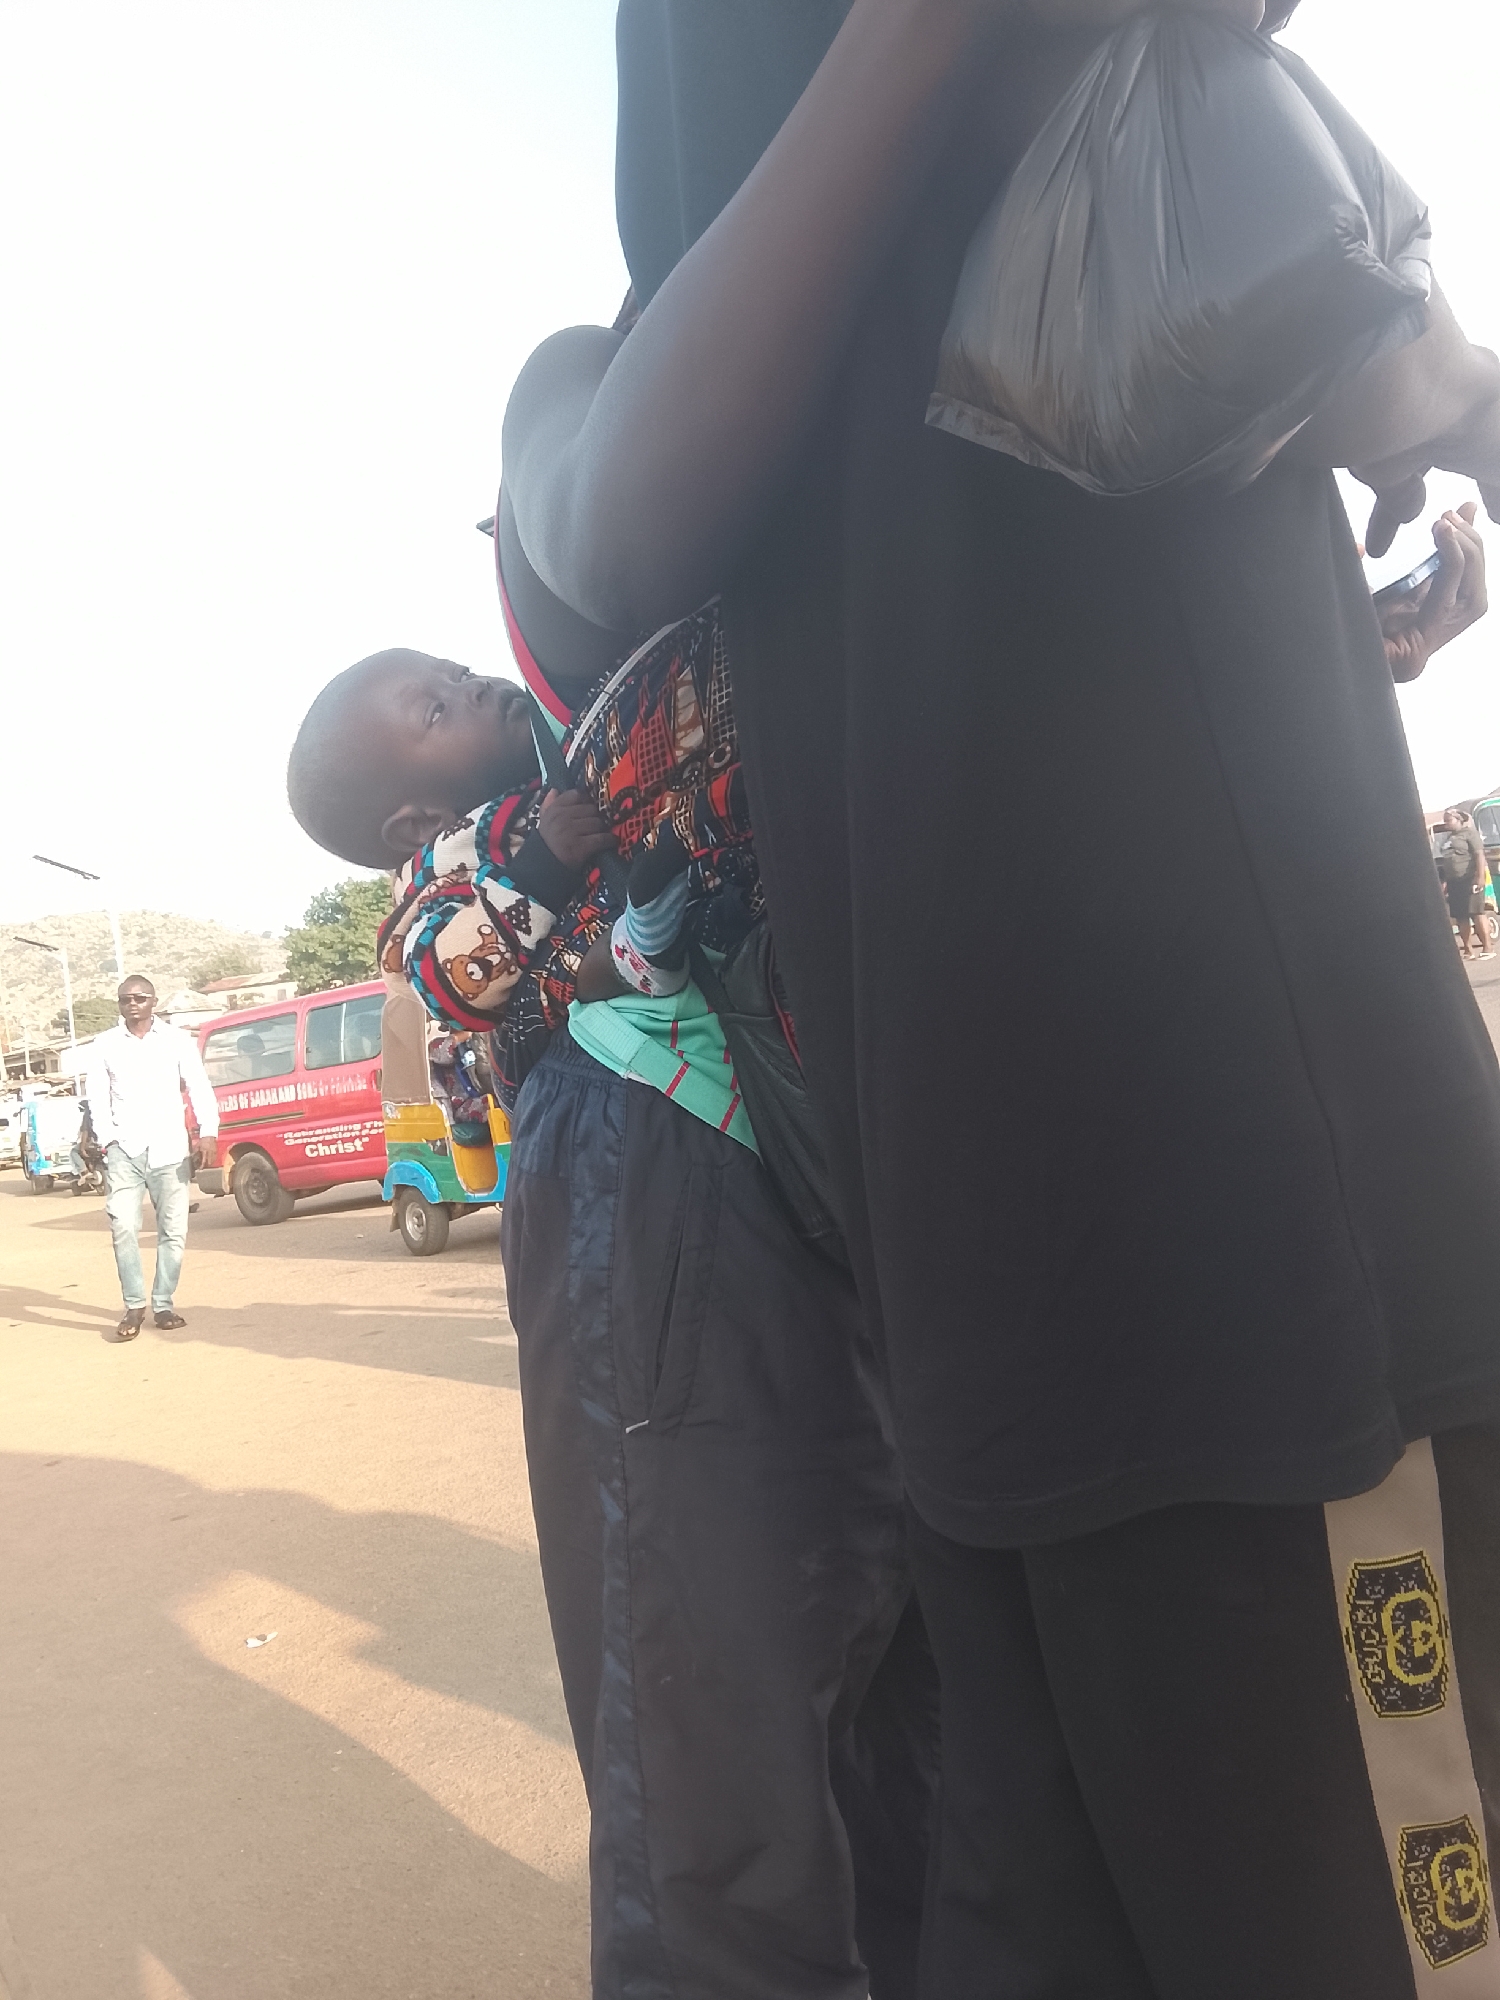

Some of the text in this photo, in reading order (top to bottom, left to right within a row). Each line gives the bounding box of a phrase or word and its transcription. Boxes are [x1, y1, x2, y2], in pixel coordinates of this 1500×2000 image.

[239, 1092, 249, 1110] OF
[278, 1084, 296, 1104] AND
[284, 1131, 360, 1146] Generation
